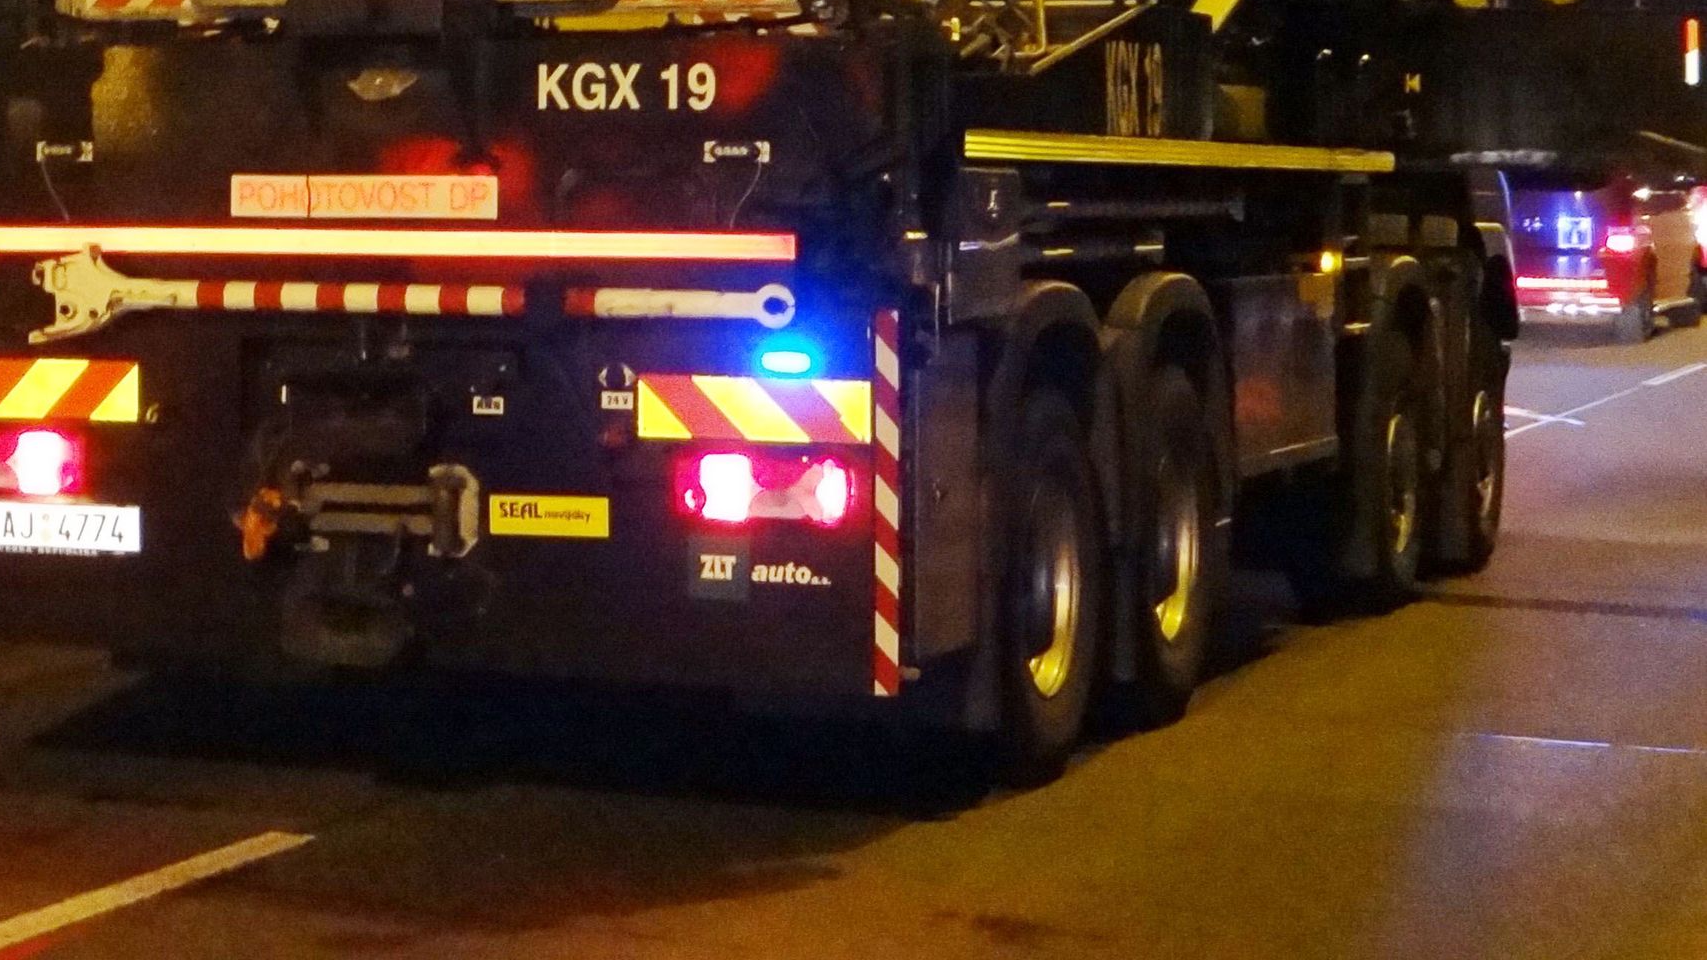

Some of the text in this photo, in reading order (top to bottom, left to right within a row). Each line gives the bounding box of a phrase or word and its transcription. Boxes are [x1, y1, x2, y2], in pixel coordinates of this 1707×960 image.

[536, 62, 717, 112] KGX 19
[238, 180, 492, 213] POHOTOVOST DP
[498, 501, 543, 520] SEAL
[58, 513, 124, 542] 4774
[699, 554, 737, 581] ZLT
[751, 561, 812, 585] auto
